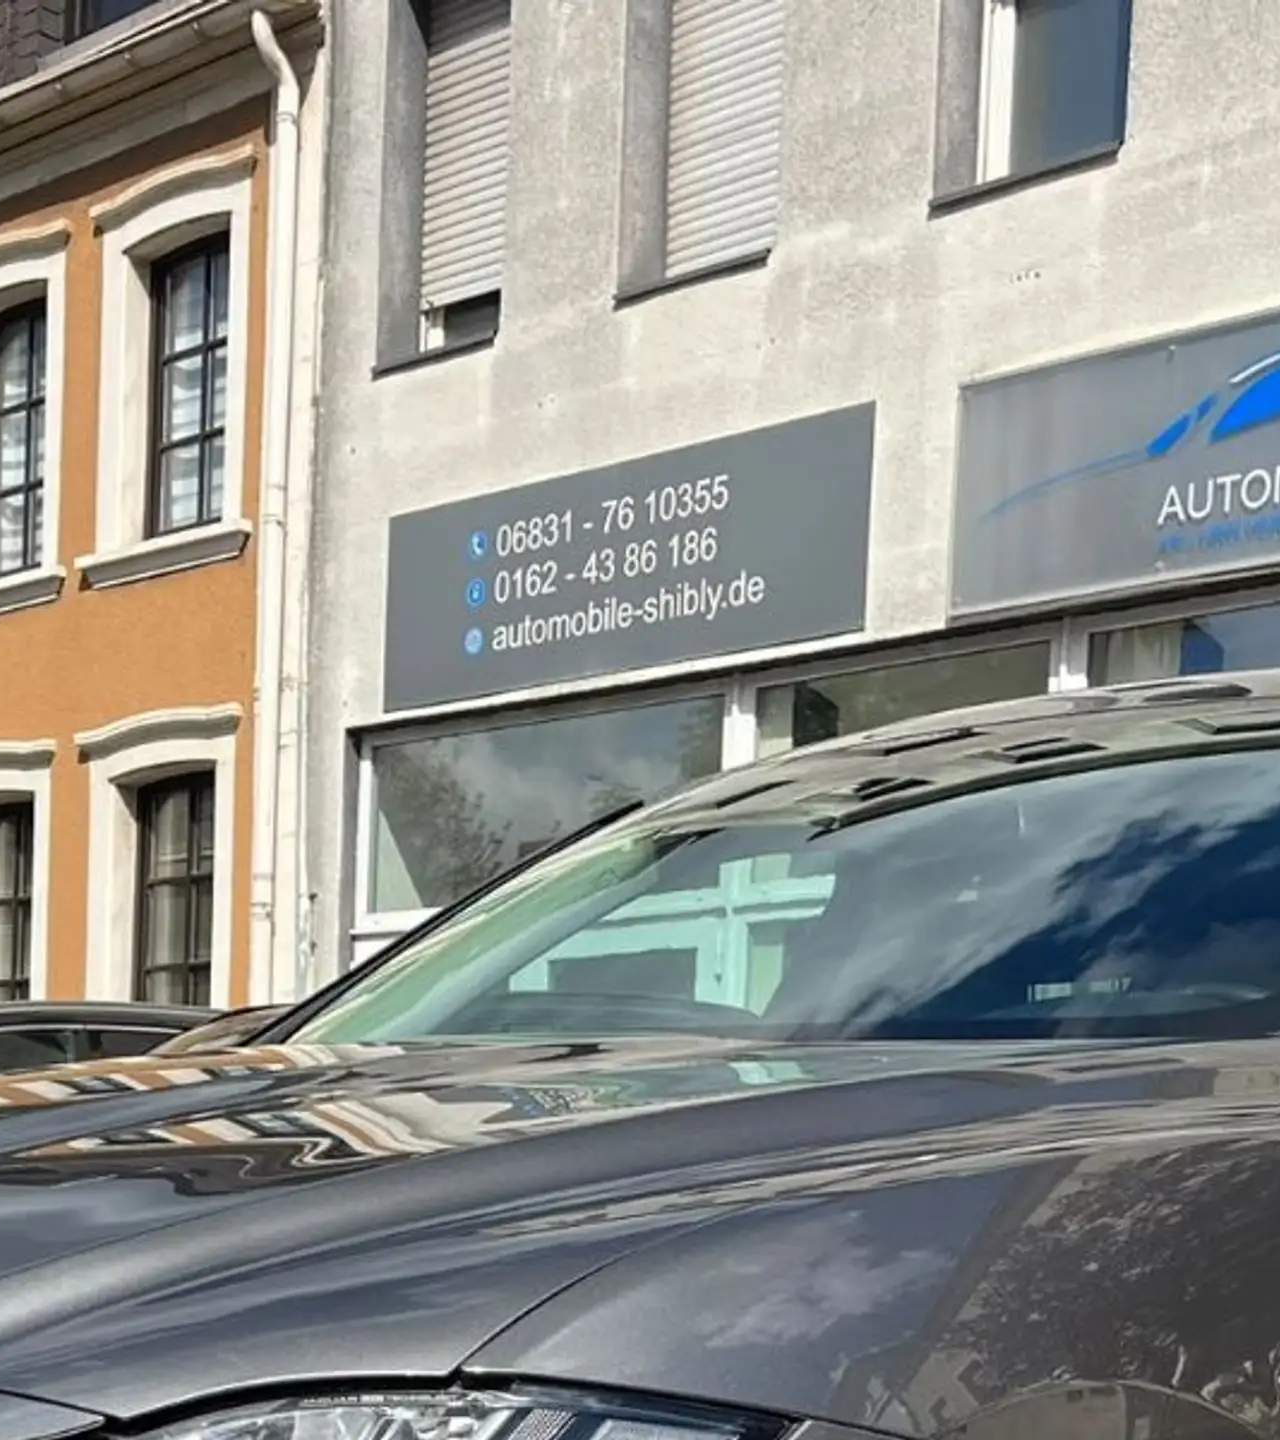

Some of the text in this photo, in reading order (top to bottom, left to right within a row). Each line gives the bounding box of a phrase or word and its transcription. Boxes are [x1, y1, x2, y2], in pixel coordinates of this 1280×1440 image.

[496, 510, 573, 557] 06831
[601, 497, 635, 536] 76
[645, 475, 729, 525] 10355
[494, 561, 557, 604] 0162
[582, 548, 615, 586] 43
[623, 538, 657, 576] 86
[668, 526, 718, 567] 186
[492, 569, 765, 651] automobile-shibly.de
